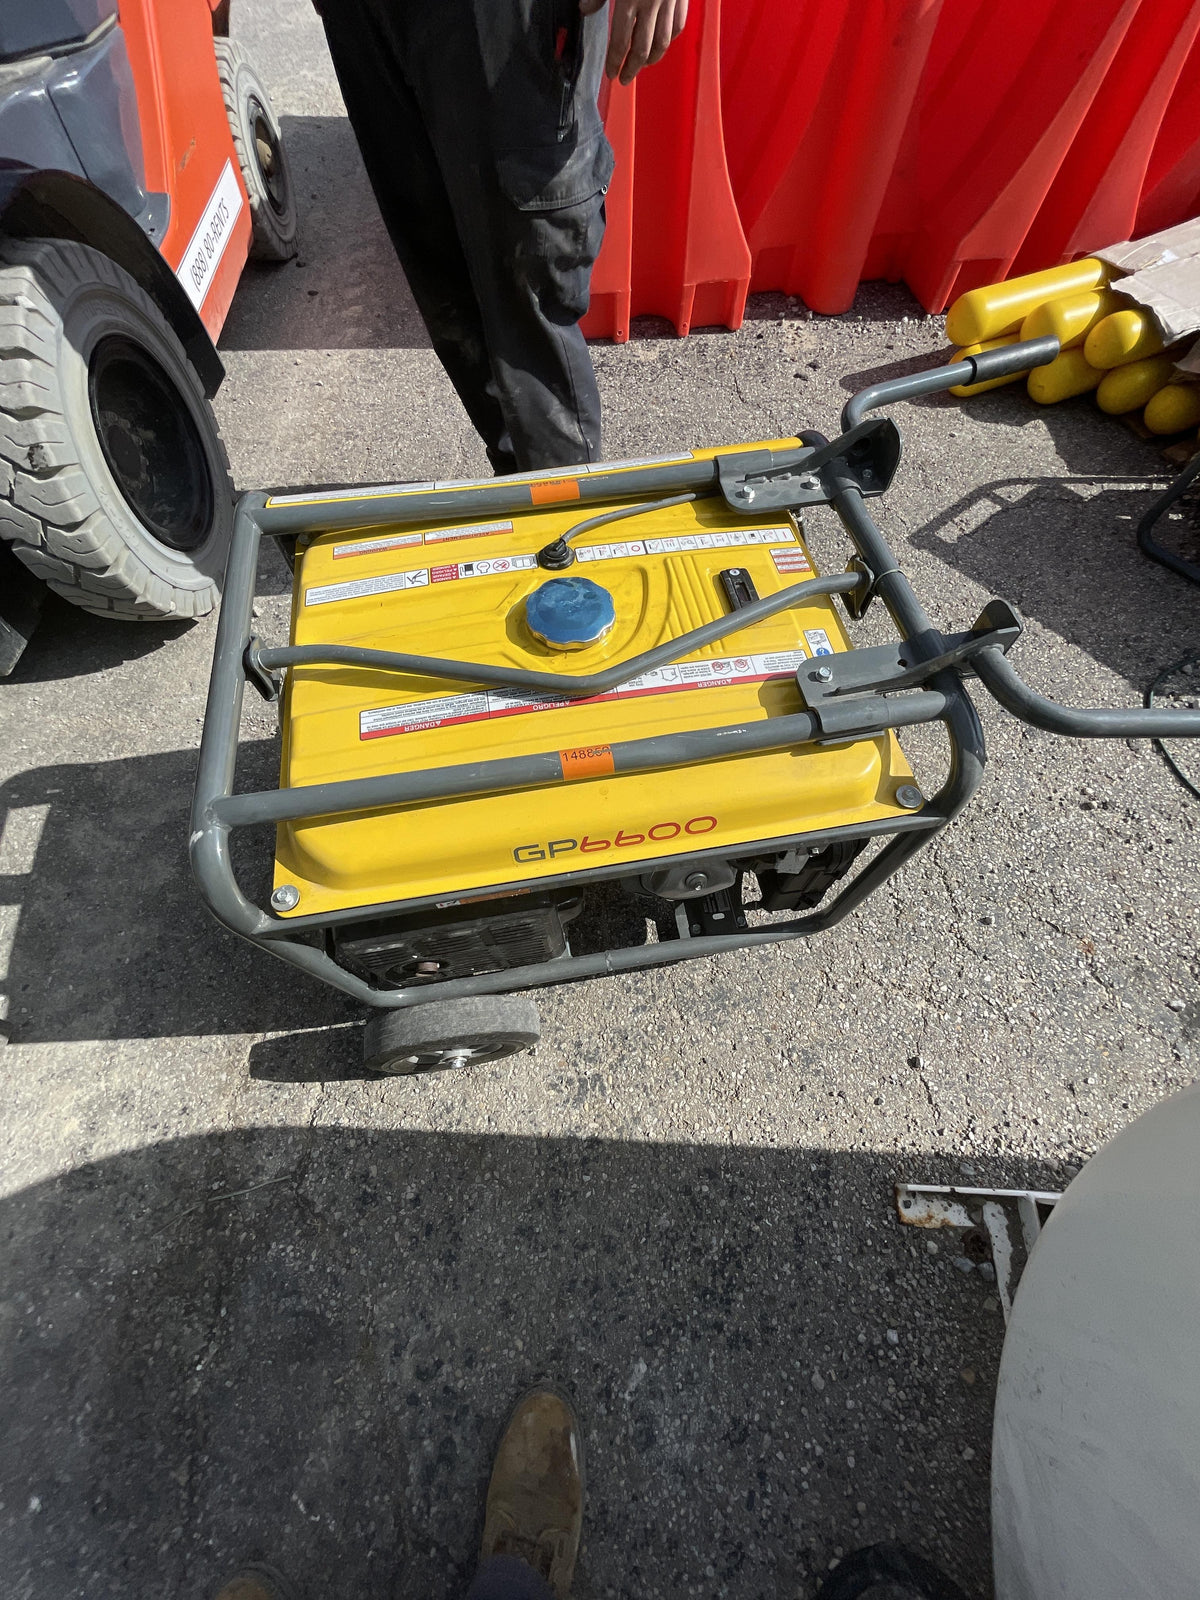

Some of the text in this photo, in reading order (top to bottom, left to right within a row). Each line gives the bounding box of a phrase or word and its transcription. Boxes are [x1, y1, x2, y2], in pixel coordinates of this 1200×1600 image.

[189, 197, 229, 293] (888) 80-RENTS
[697, 678, 726, 689] DANGER
[532, 701, 564, 712] PELIGRO
[404, 720, 435, 733] DANGER
[513, 815, 718, 864] GP6600
